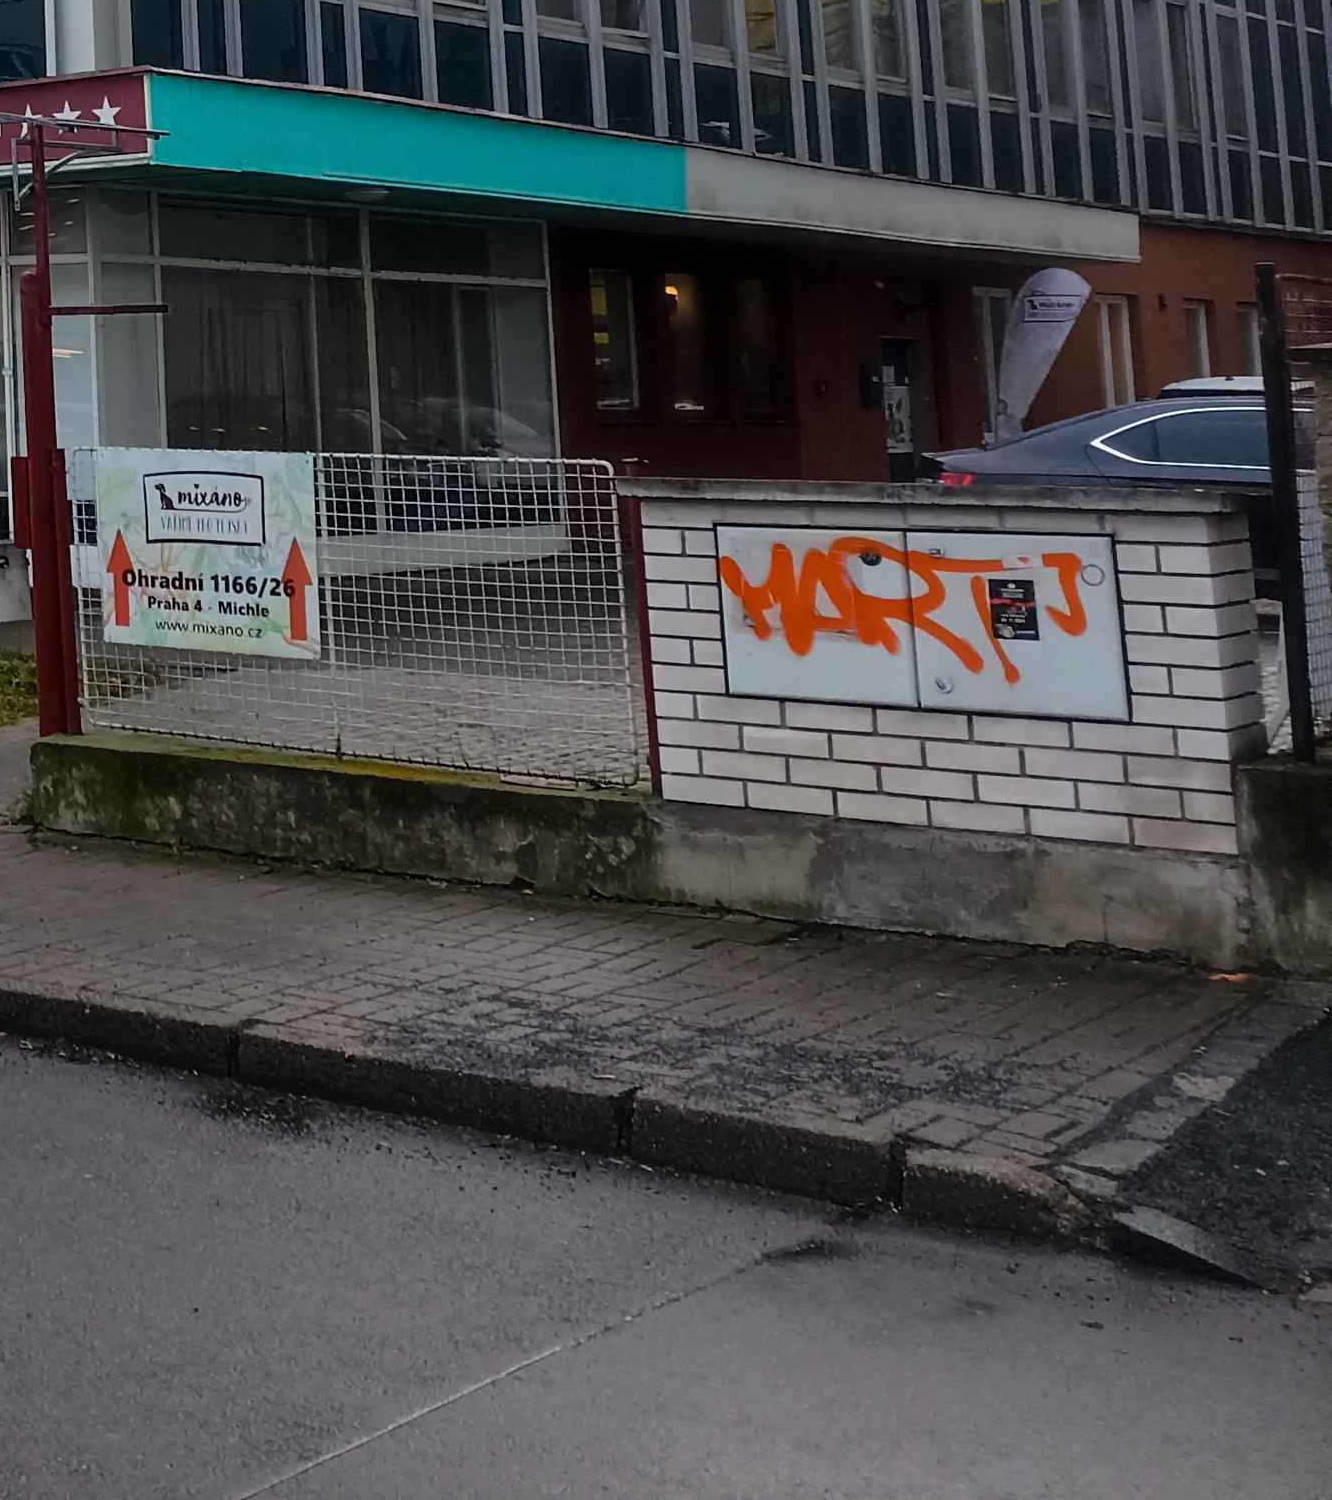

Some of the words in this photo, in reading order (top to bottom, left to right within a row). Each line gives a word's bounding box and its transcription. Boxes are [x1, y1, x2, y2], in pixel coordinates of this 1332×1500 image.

[122, 569, 204, 592] Ohradní
[211, 574, 296, 598] 1166/26
[148, 596, 189, 612] Praha
[194, 600, 203, 612] 4
[218, 602, 270, 617] Michle
[155, 620, 263, 638] www.mixano.cz
